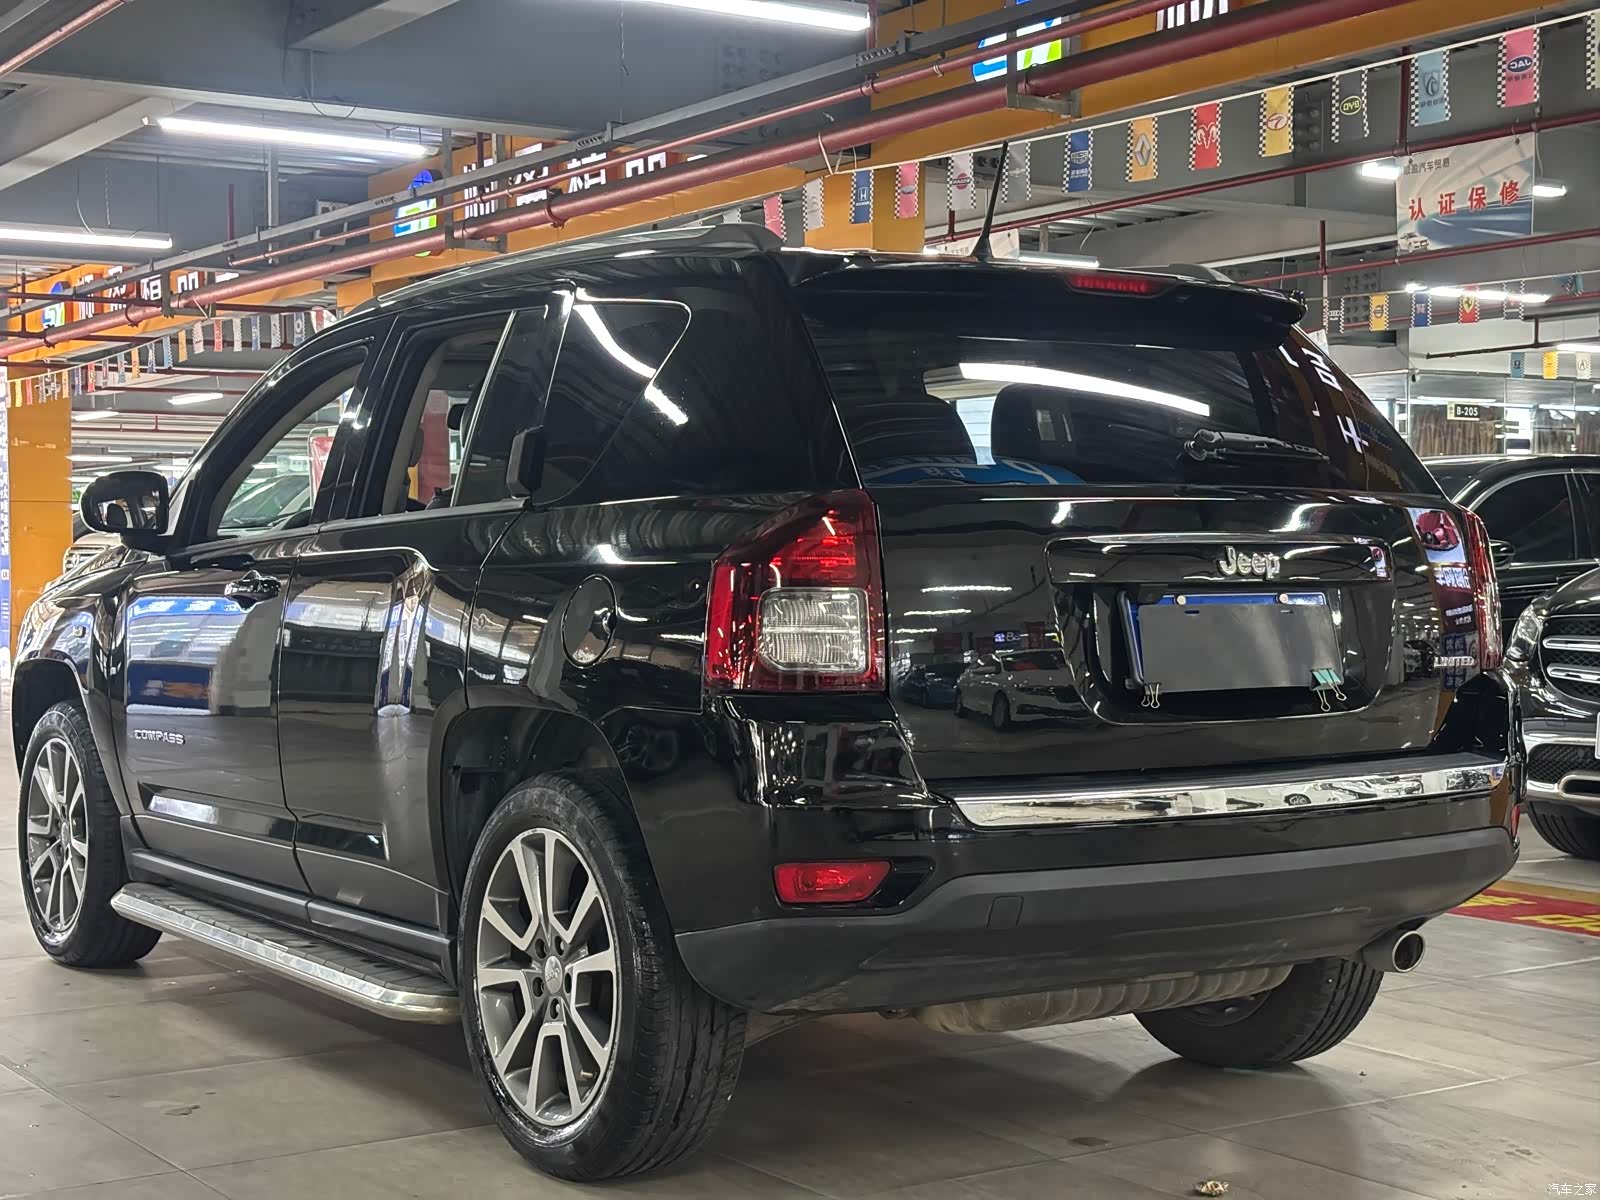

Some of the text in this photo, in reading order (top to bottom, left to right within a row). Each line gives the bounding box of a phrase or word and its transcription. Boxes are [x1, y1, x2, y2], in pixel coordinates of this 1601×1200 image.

[1409, 180, 1519, 221] 认证保修
[1456, 406, 1478, 416] B-205
[1219, 546, 1280, 579] Jeep
[1434, 656, 1474, 667] LIMITED
[134, 729, 184, 744] COMPASS
